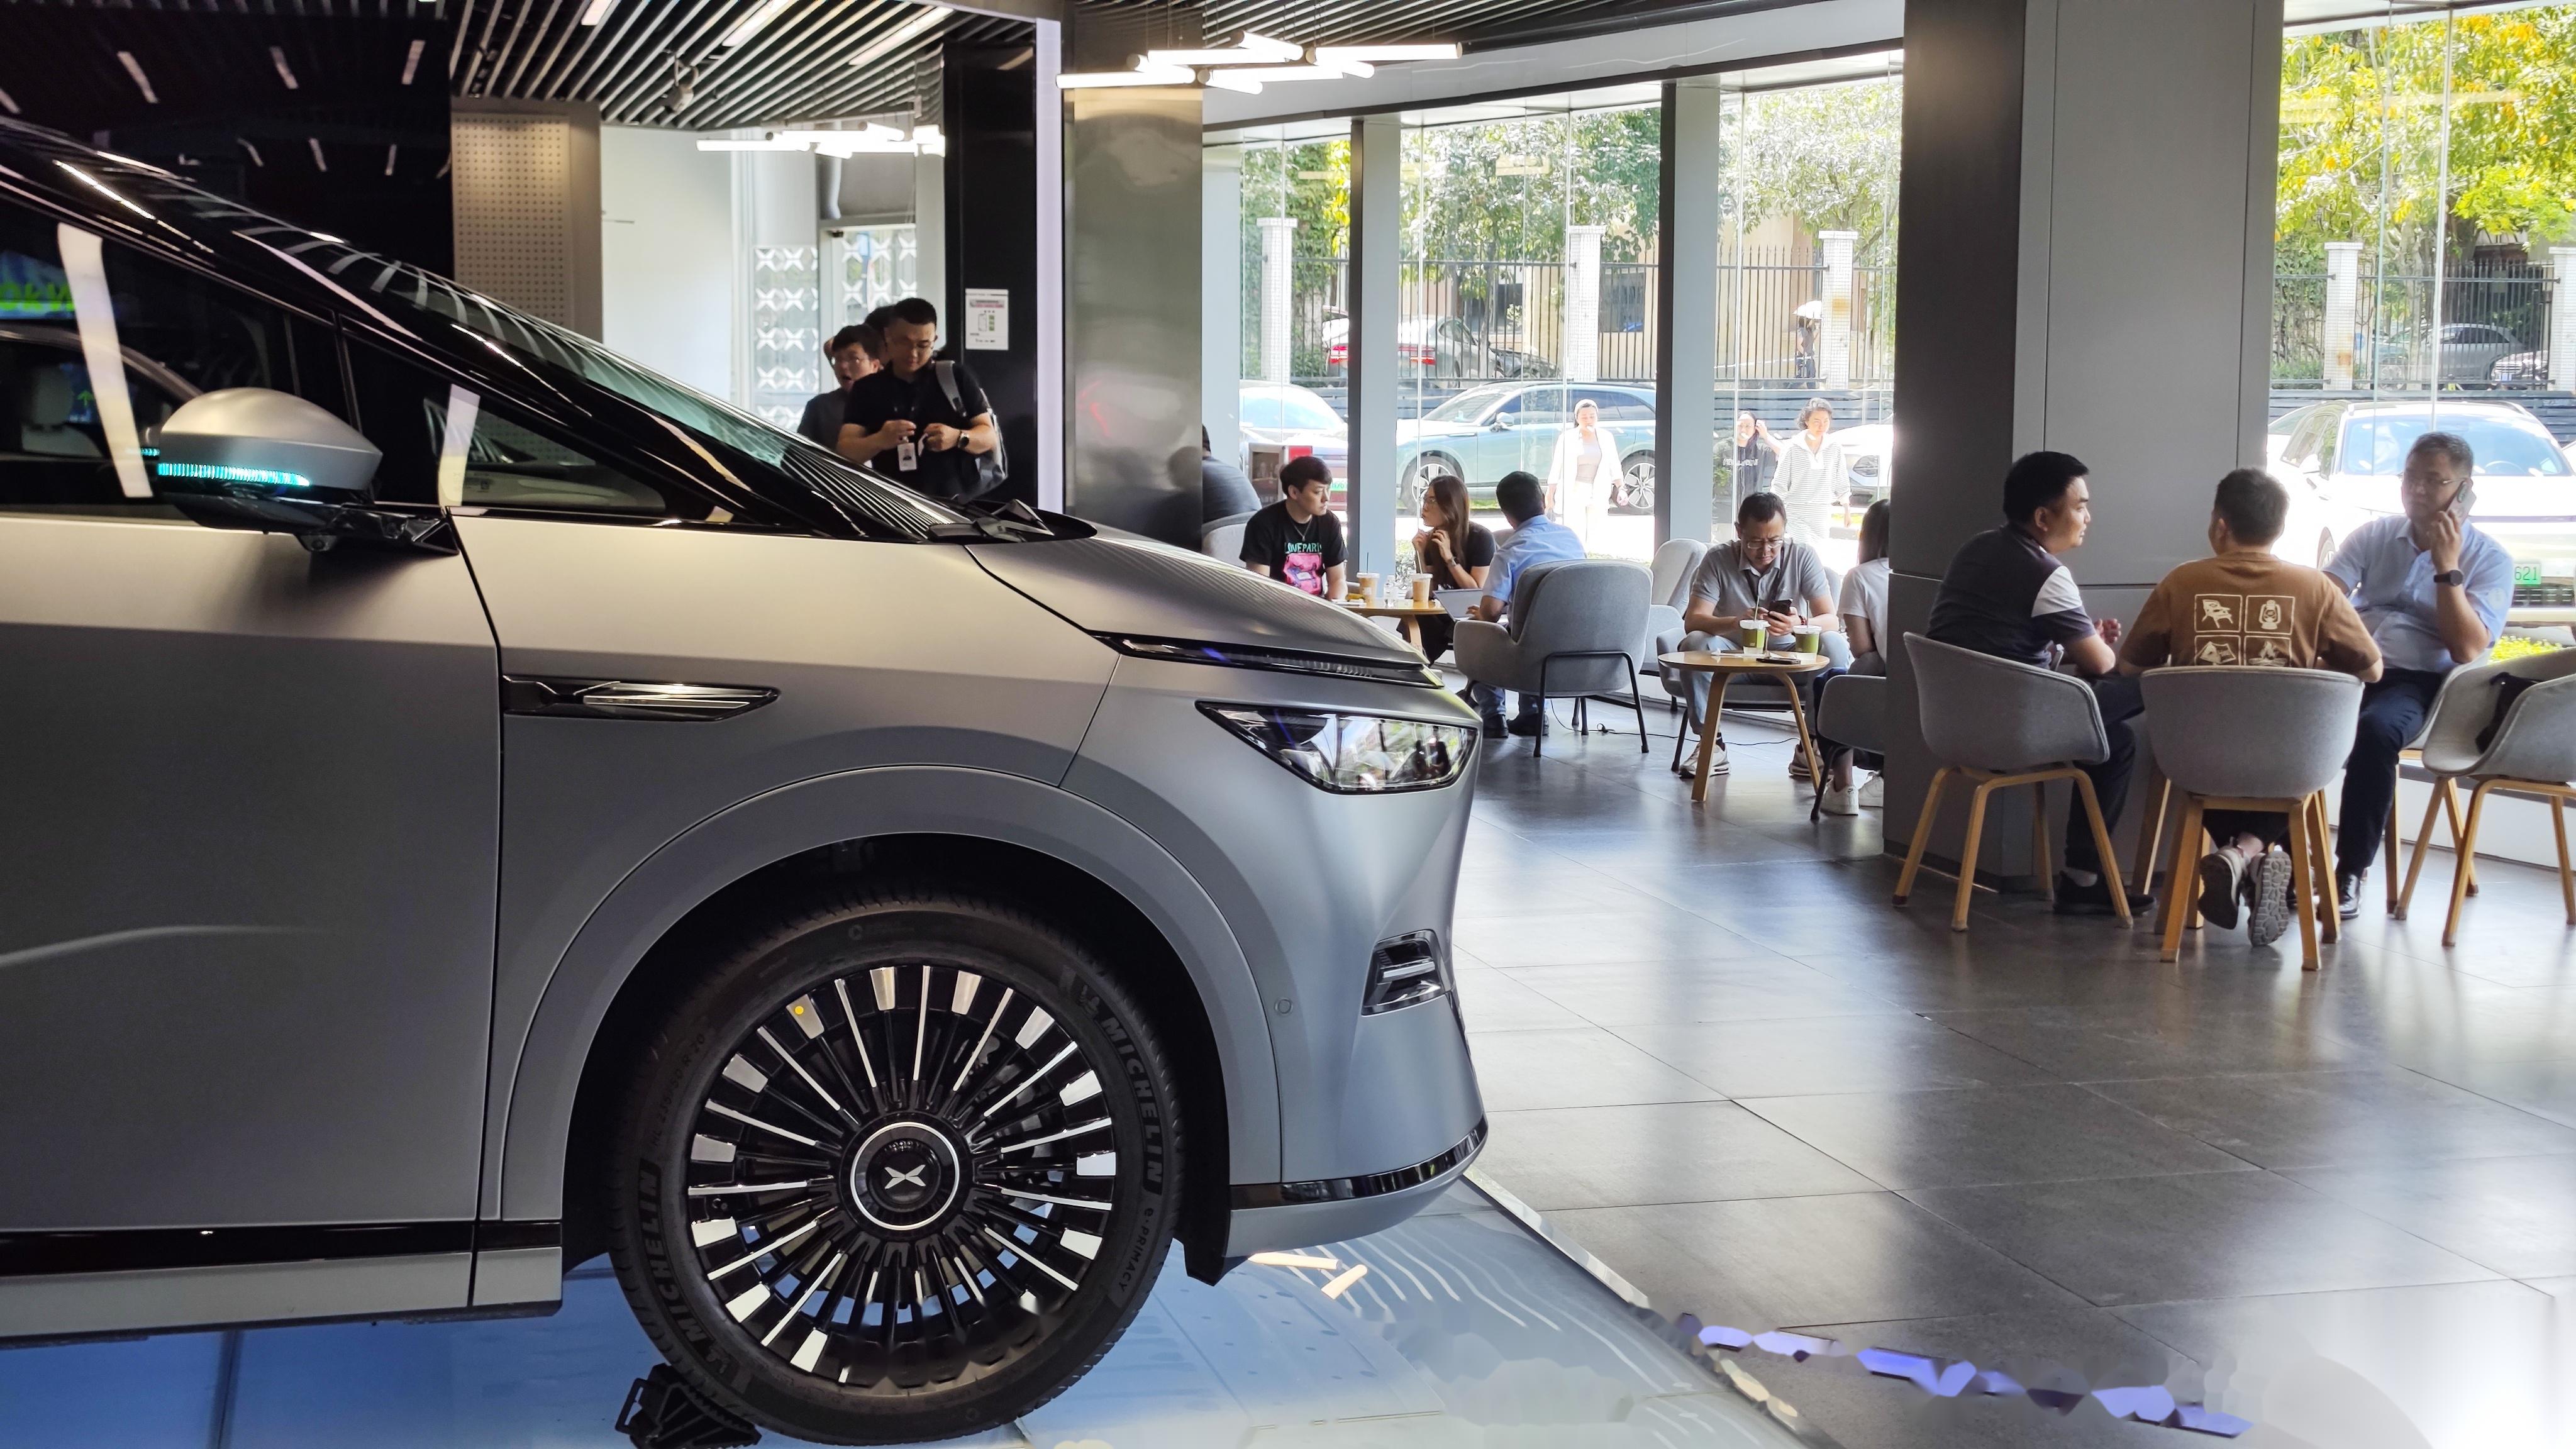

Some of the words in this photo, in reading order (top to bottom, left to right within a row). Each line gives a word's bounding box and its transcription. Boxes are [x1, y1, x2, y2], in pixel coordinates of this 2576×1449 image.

[2514, 566, 2538, 580] 621
[1101, 1016, 1163, 1184] MICHELIN
[639, 1171, 708, 1342] MICHELIN
